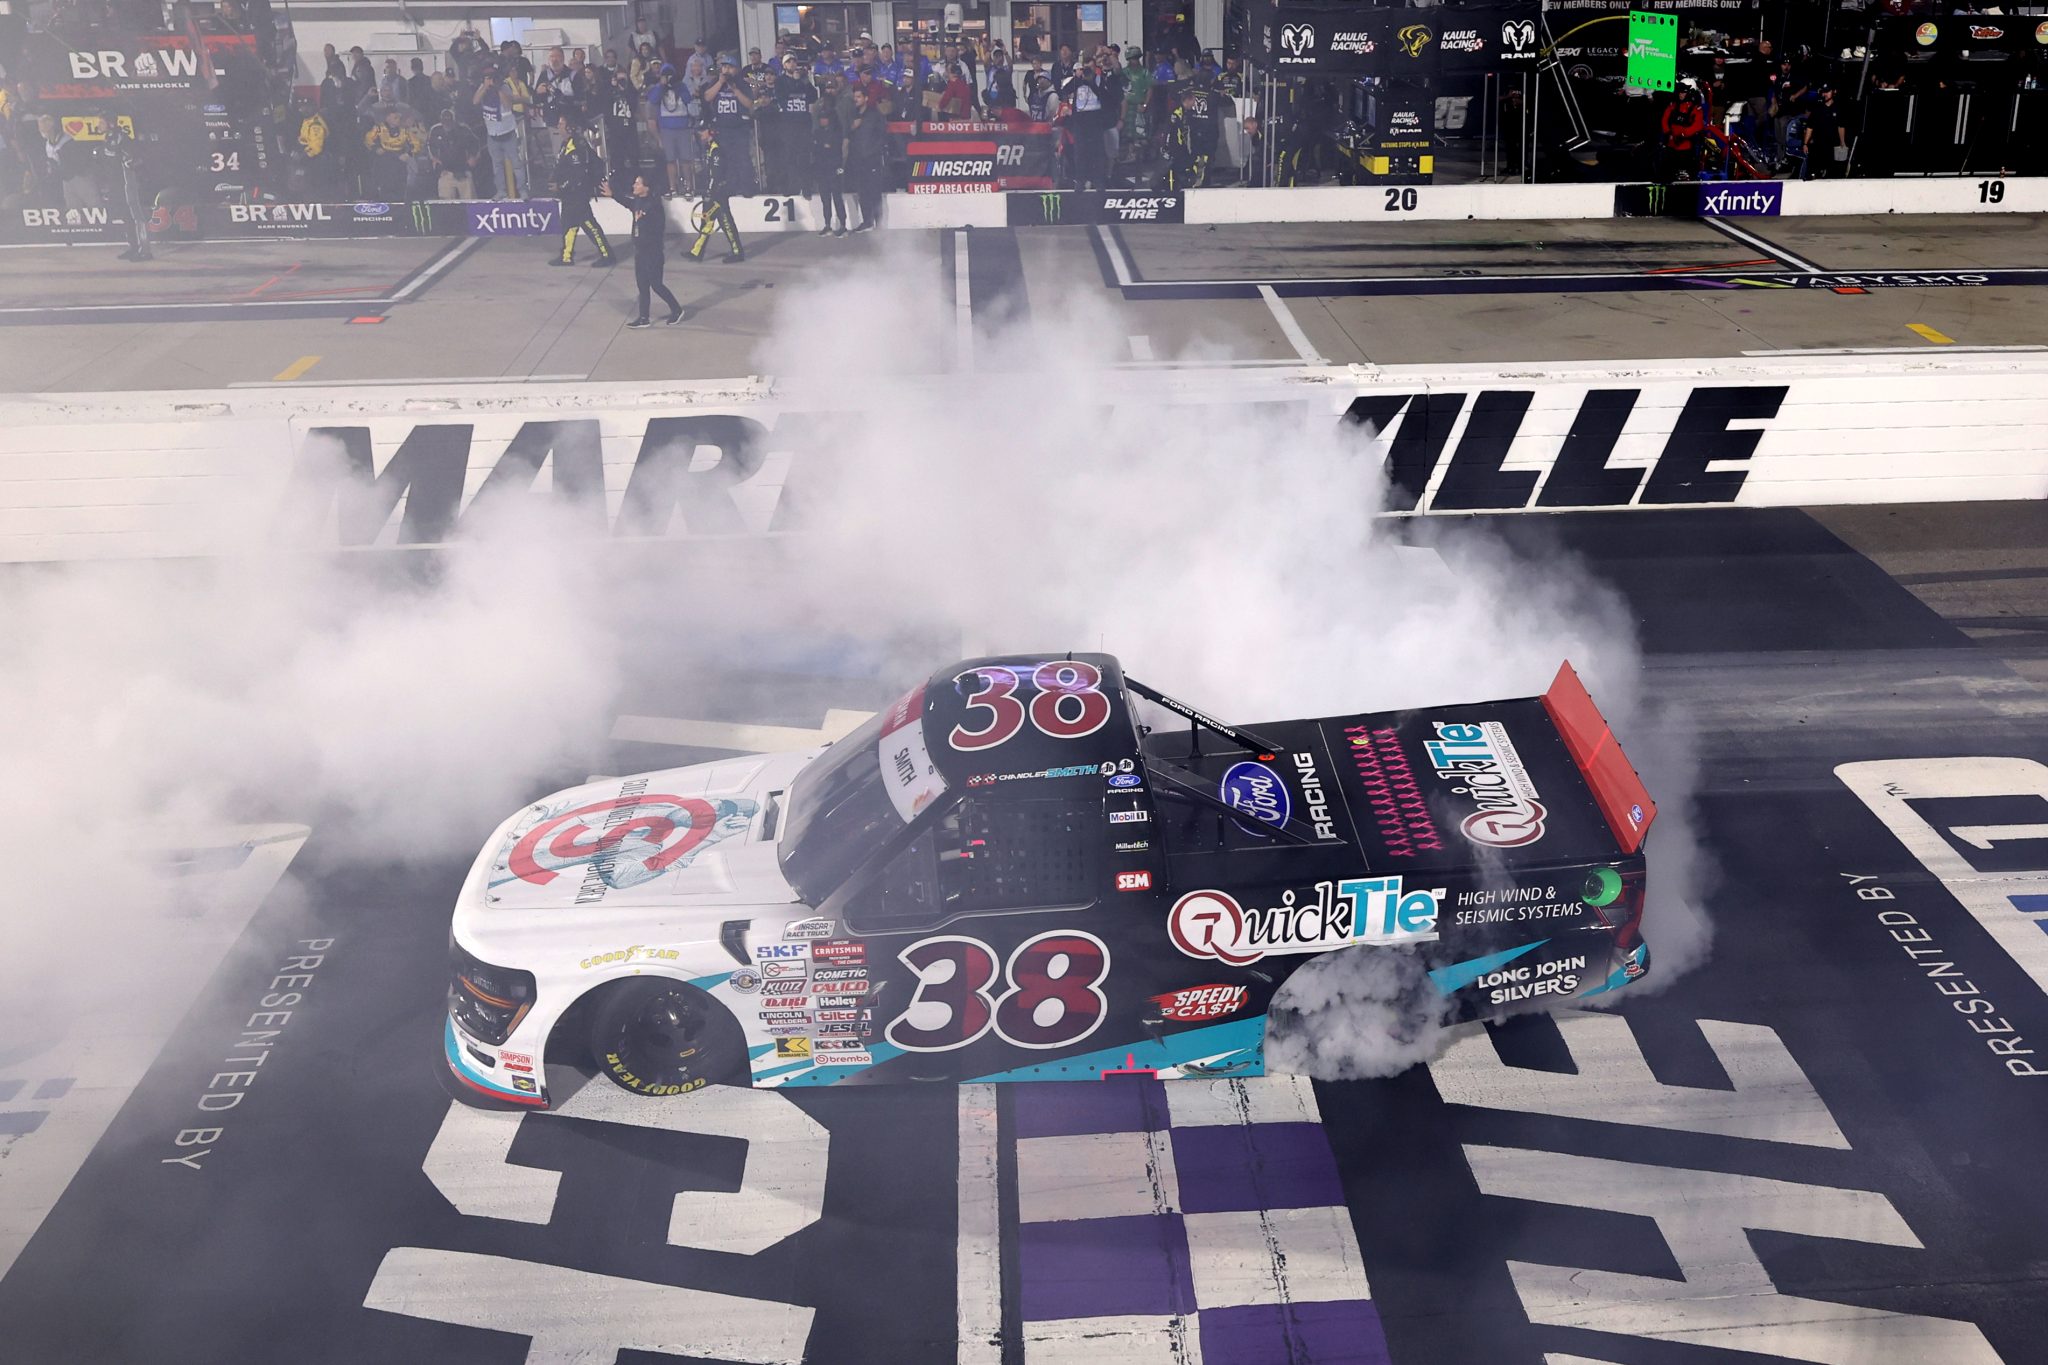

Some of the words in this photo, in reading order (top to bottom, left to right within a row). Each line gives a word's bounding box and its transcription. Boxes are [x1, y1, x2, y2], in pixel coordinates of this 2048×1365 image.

[1564, 0, 1607, 9] MEMBERS
[1610, 1, 1631, 9] ONLY
[1676, 0, 1719, 9] MEMBERS
[1720, 0, 1742, 9] ONLY
[1333, 32, 1368, 41] KAULIG
[1442, 30, 1477, 40] KAULIG
[1330, 41, 1366, 51] RACING
[1440, 40, 1476, 50] RACING
[930, 122, 945, 131] DO
[948, 122, 970, 131] NOT
[973, 122, 1009, 132] ENTER
[210, 151, 240, 172] 34
[932, 161, 993, 177] NASCAR
[914, 184, 937, 195] KEEP
[939, 184, 963, 194] AREA
[964, 183, 992, 194] CLEAR
[1978, 180, 2005, 204] 19
[1103, 197, 1177, 209] BLACK'S
[1384, 187, 1418, 212] 20
[1704, 190, 1775, 215] xfinity
[763, 197, 797, 223] 21
[1119, 208, 1159, 220] TIRE
[476, 206, 553, 234] xfinity
[1773, 274, 1989, 285] VABYSMO
[948, 660, 1111, 752] 38
[1161, 696, 1193, 717] FORD
[1194, 712, 1236, 738] RACING
[894, 747, 918, 788] SMITH
[999, 771, 1049, 781] CHANDLER
[1044, 764, 1099, 779] SMITH
[1427, 723, 1548, 846] QuickTie
[1292, 752, 1337, 839] RACING
[1111, 812, 1135, 822] Mobil
[1115, 840, 1149, 850] Millertech
[1118, 872, 1150, 890] SEM
[1840, 871, 1896, 902] BY
[1457, 890, 1496, 906] HIGH
[1501, 887, 1543, 904] WIND
[1545, 885, 1557, 900] &
[1170, 879, 1435, 963] QuickTie
[1456, 907, 1515, 925] SEISMIC
[1518, 901, 1583, 921] SYSTEMS
[801, 922, 828, 930] NASCAR
[756, 944, 808, 959] SKF
[814, 946, 863, 955] CRAFTSMAN
[814, 968, 867, 980] COMETIC
[1478, 967, 1531, 989] LONG
[1536, 956, 1586, 978] JOHN
[766, 981, 803, 991] KLOTZ
[812, 981, 869, 993] CALICO
[884, 929, 1112, 1053] 38
[1490, 974, 1580, 1005] SILVER'S
[1877, 910, 2048, 1077] PRESENTED
[820, 996, 857, 1007] Holley
[1174, 985, 1247, 1007] SPEEDY
[761, 1011, 803, 1019] LINCOLN
[1177, 1001, 1240, 1017] CA$H
[197, 937, 335, 1112] PRESENTED
[815, 1040, 863, 1050] KOOKS
[500, 1051, 531, 1064] SIMPSON
[829, 1054, 870, 1063] brembo
[162, 1127, 224, 1170] BY
